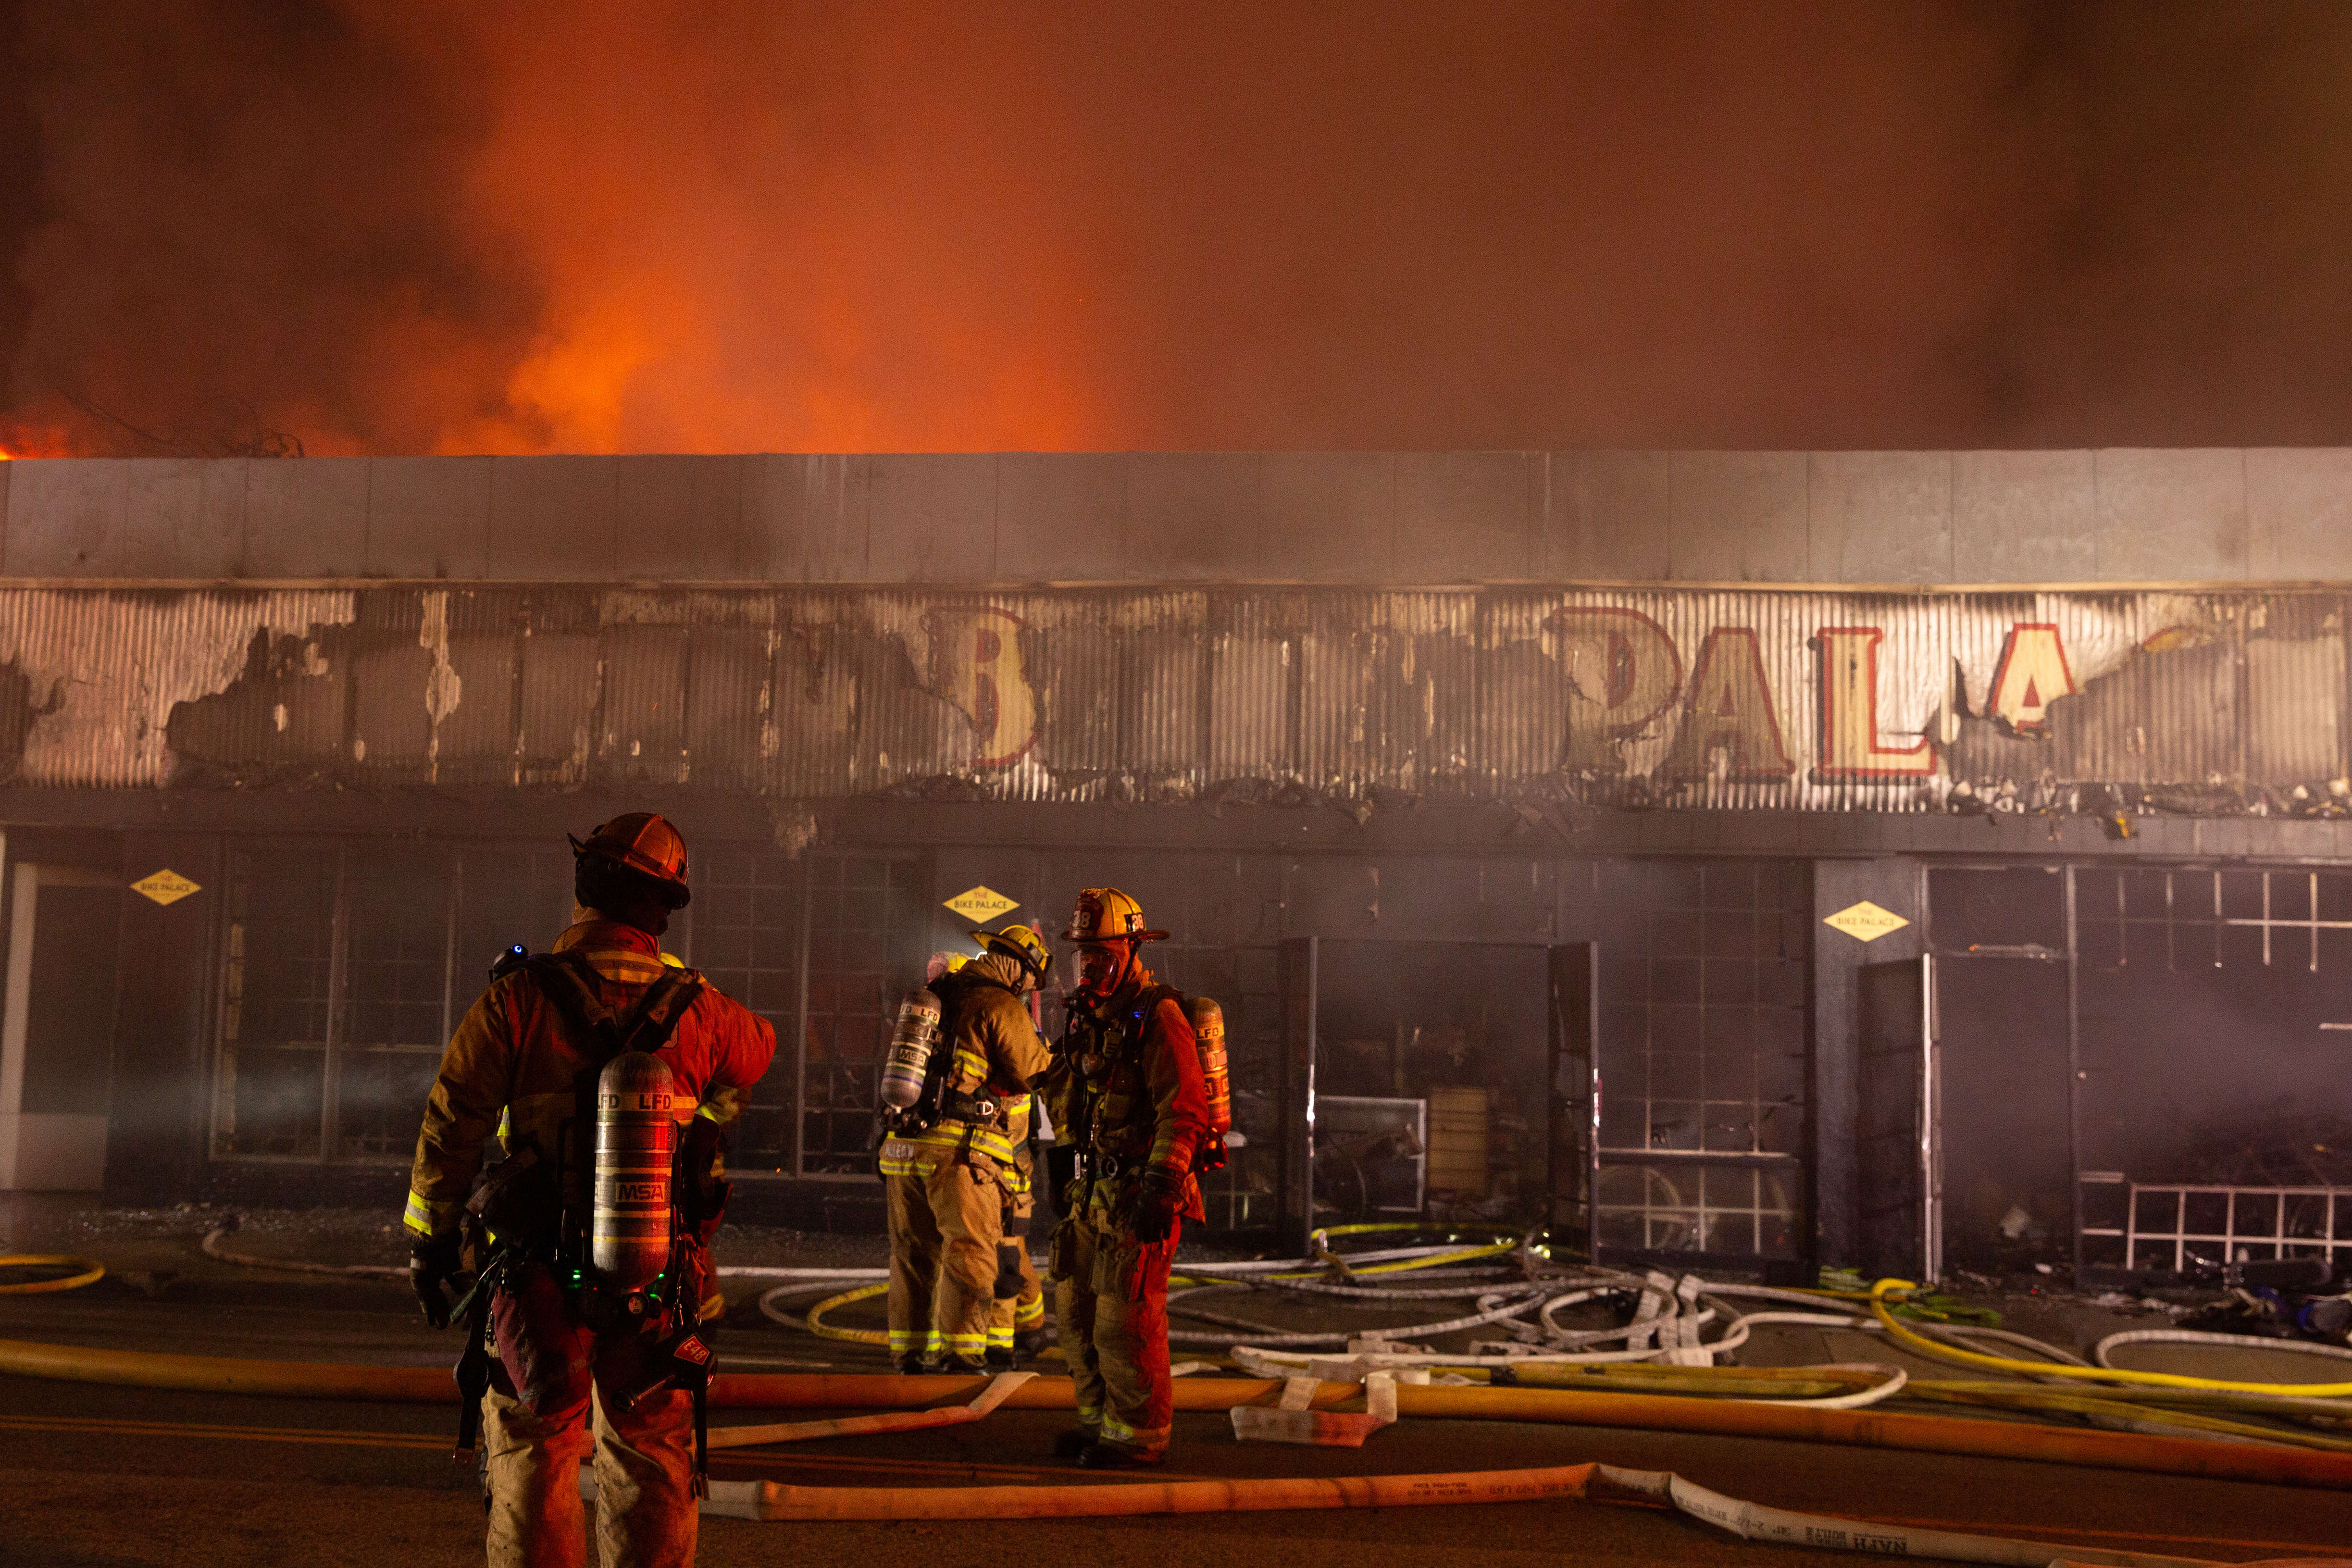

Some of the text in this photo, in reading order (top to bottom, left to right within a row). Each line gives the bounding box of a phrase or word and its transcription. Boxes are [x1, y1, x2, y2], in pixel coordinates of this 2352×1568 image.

[1541, 607, 2221, 788] PALA
[954, 900, 1007, 909] BIKE PALACE
[1837, 916, 1894, 927] BIKE PALACE
[921, 1008, 938, 1021] LFD
[1196, 1027, 1219, 1039] LFD
[901, 1049, 925, 1065] MSA
[639, 1094, 671, 1109] LFD
[618, 1184, 663, 1200] MSA
[684, 1341, 707, 1361] E48
